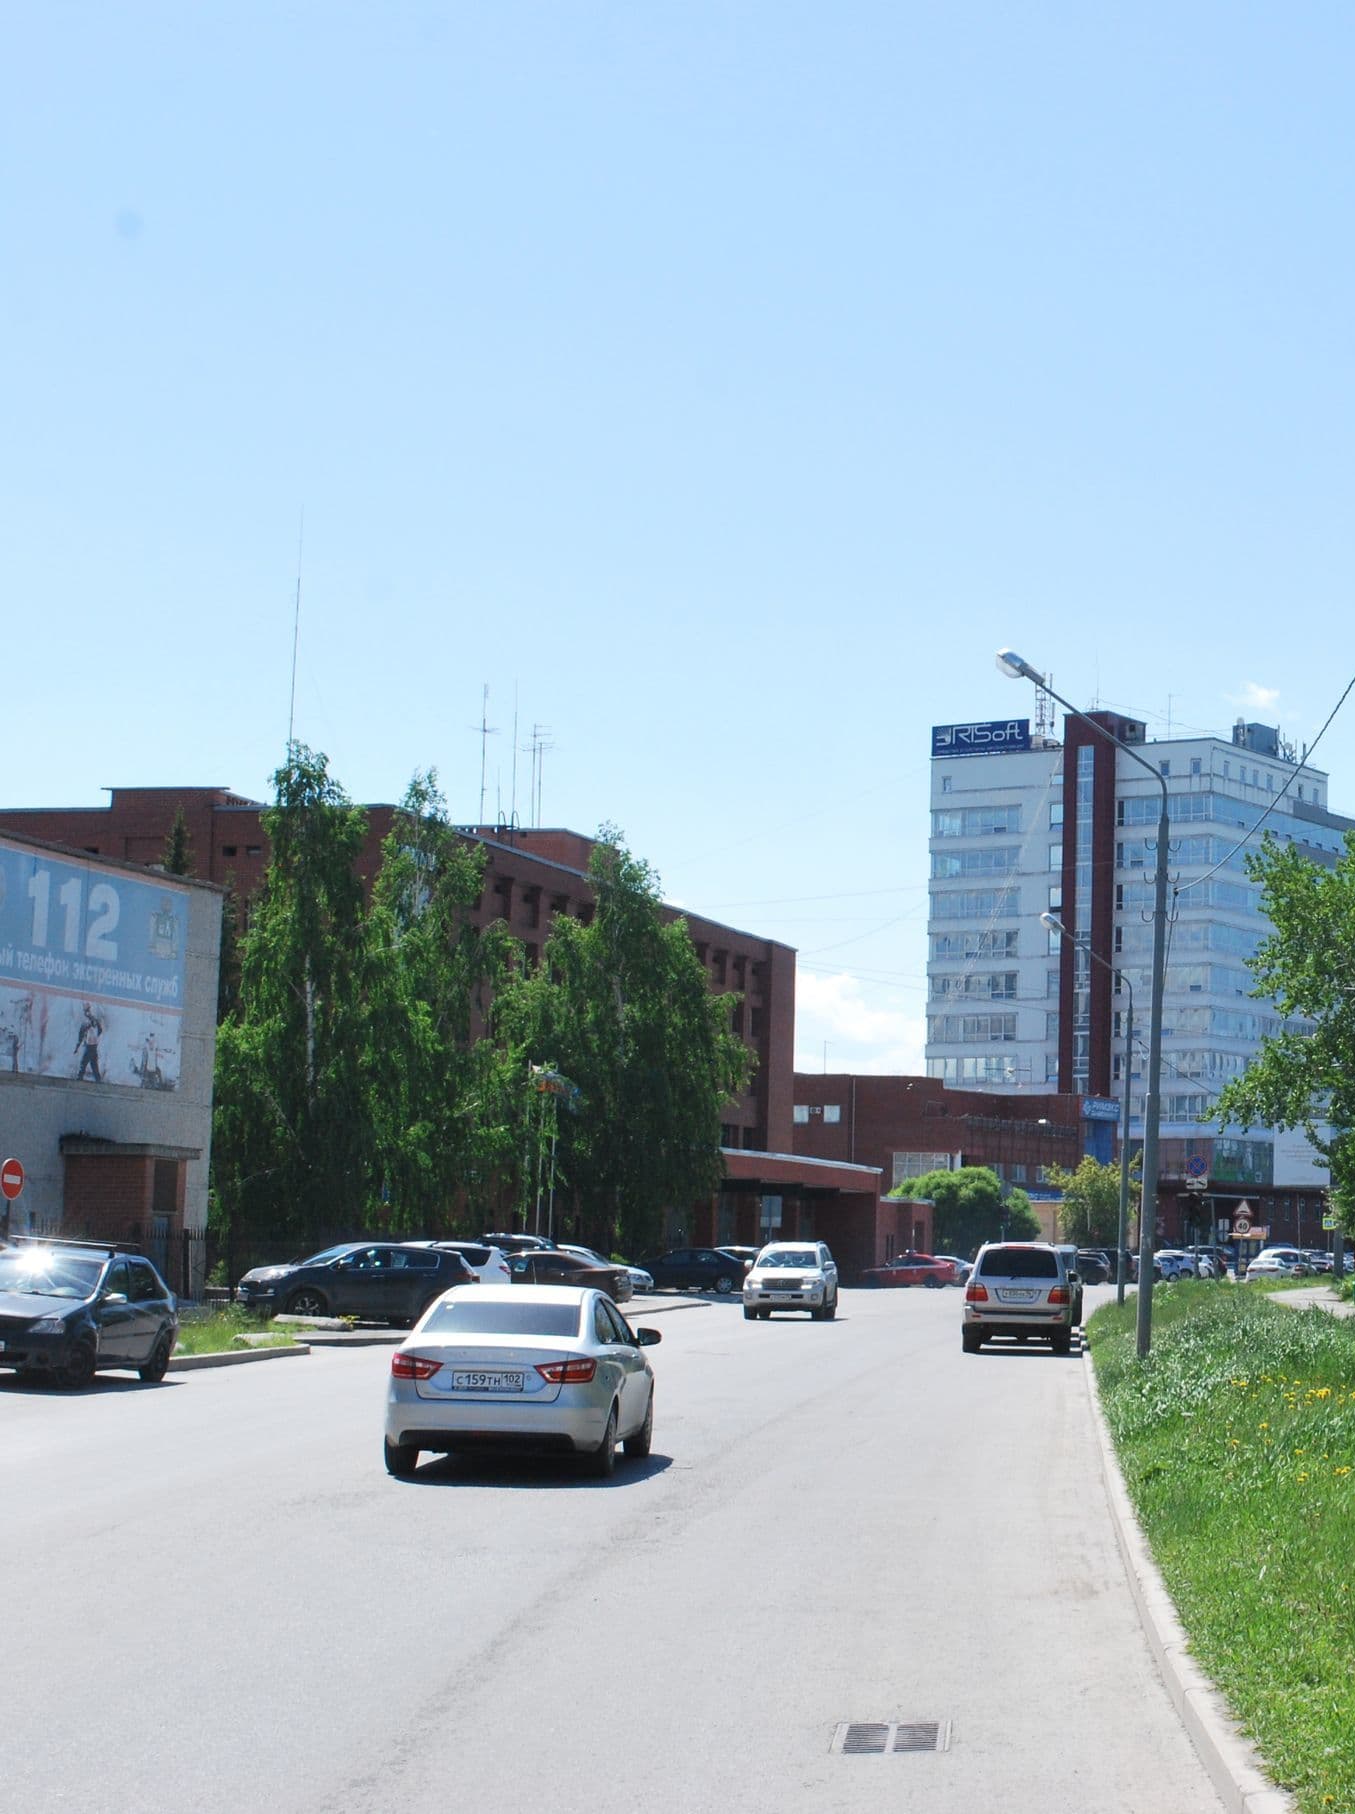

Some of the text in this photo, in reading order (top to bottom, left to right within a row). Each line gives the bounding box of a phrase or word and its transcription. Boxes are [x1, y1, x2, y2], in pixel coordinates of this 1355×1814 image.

[28, 869, 121, 960] 112
[17, 950, 70, 979] телефон
[72, 962, 143, 991] экстренных
[144, 975, 179, 1000] служб
[1238, 1222, 1248, 1230] 40
